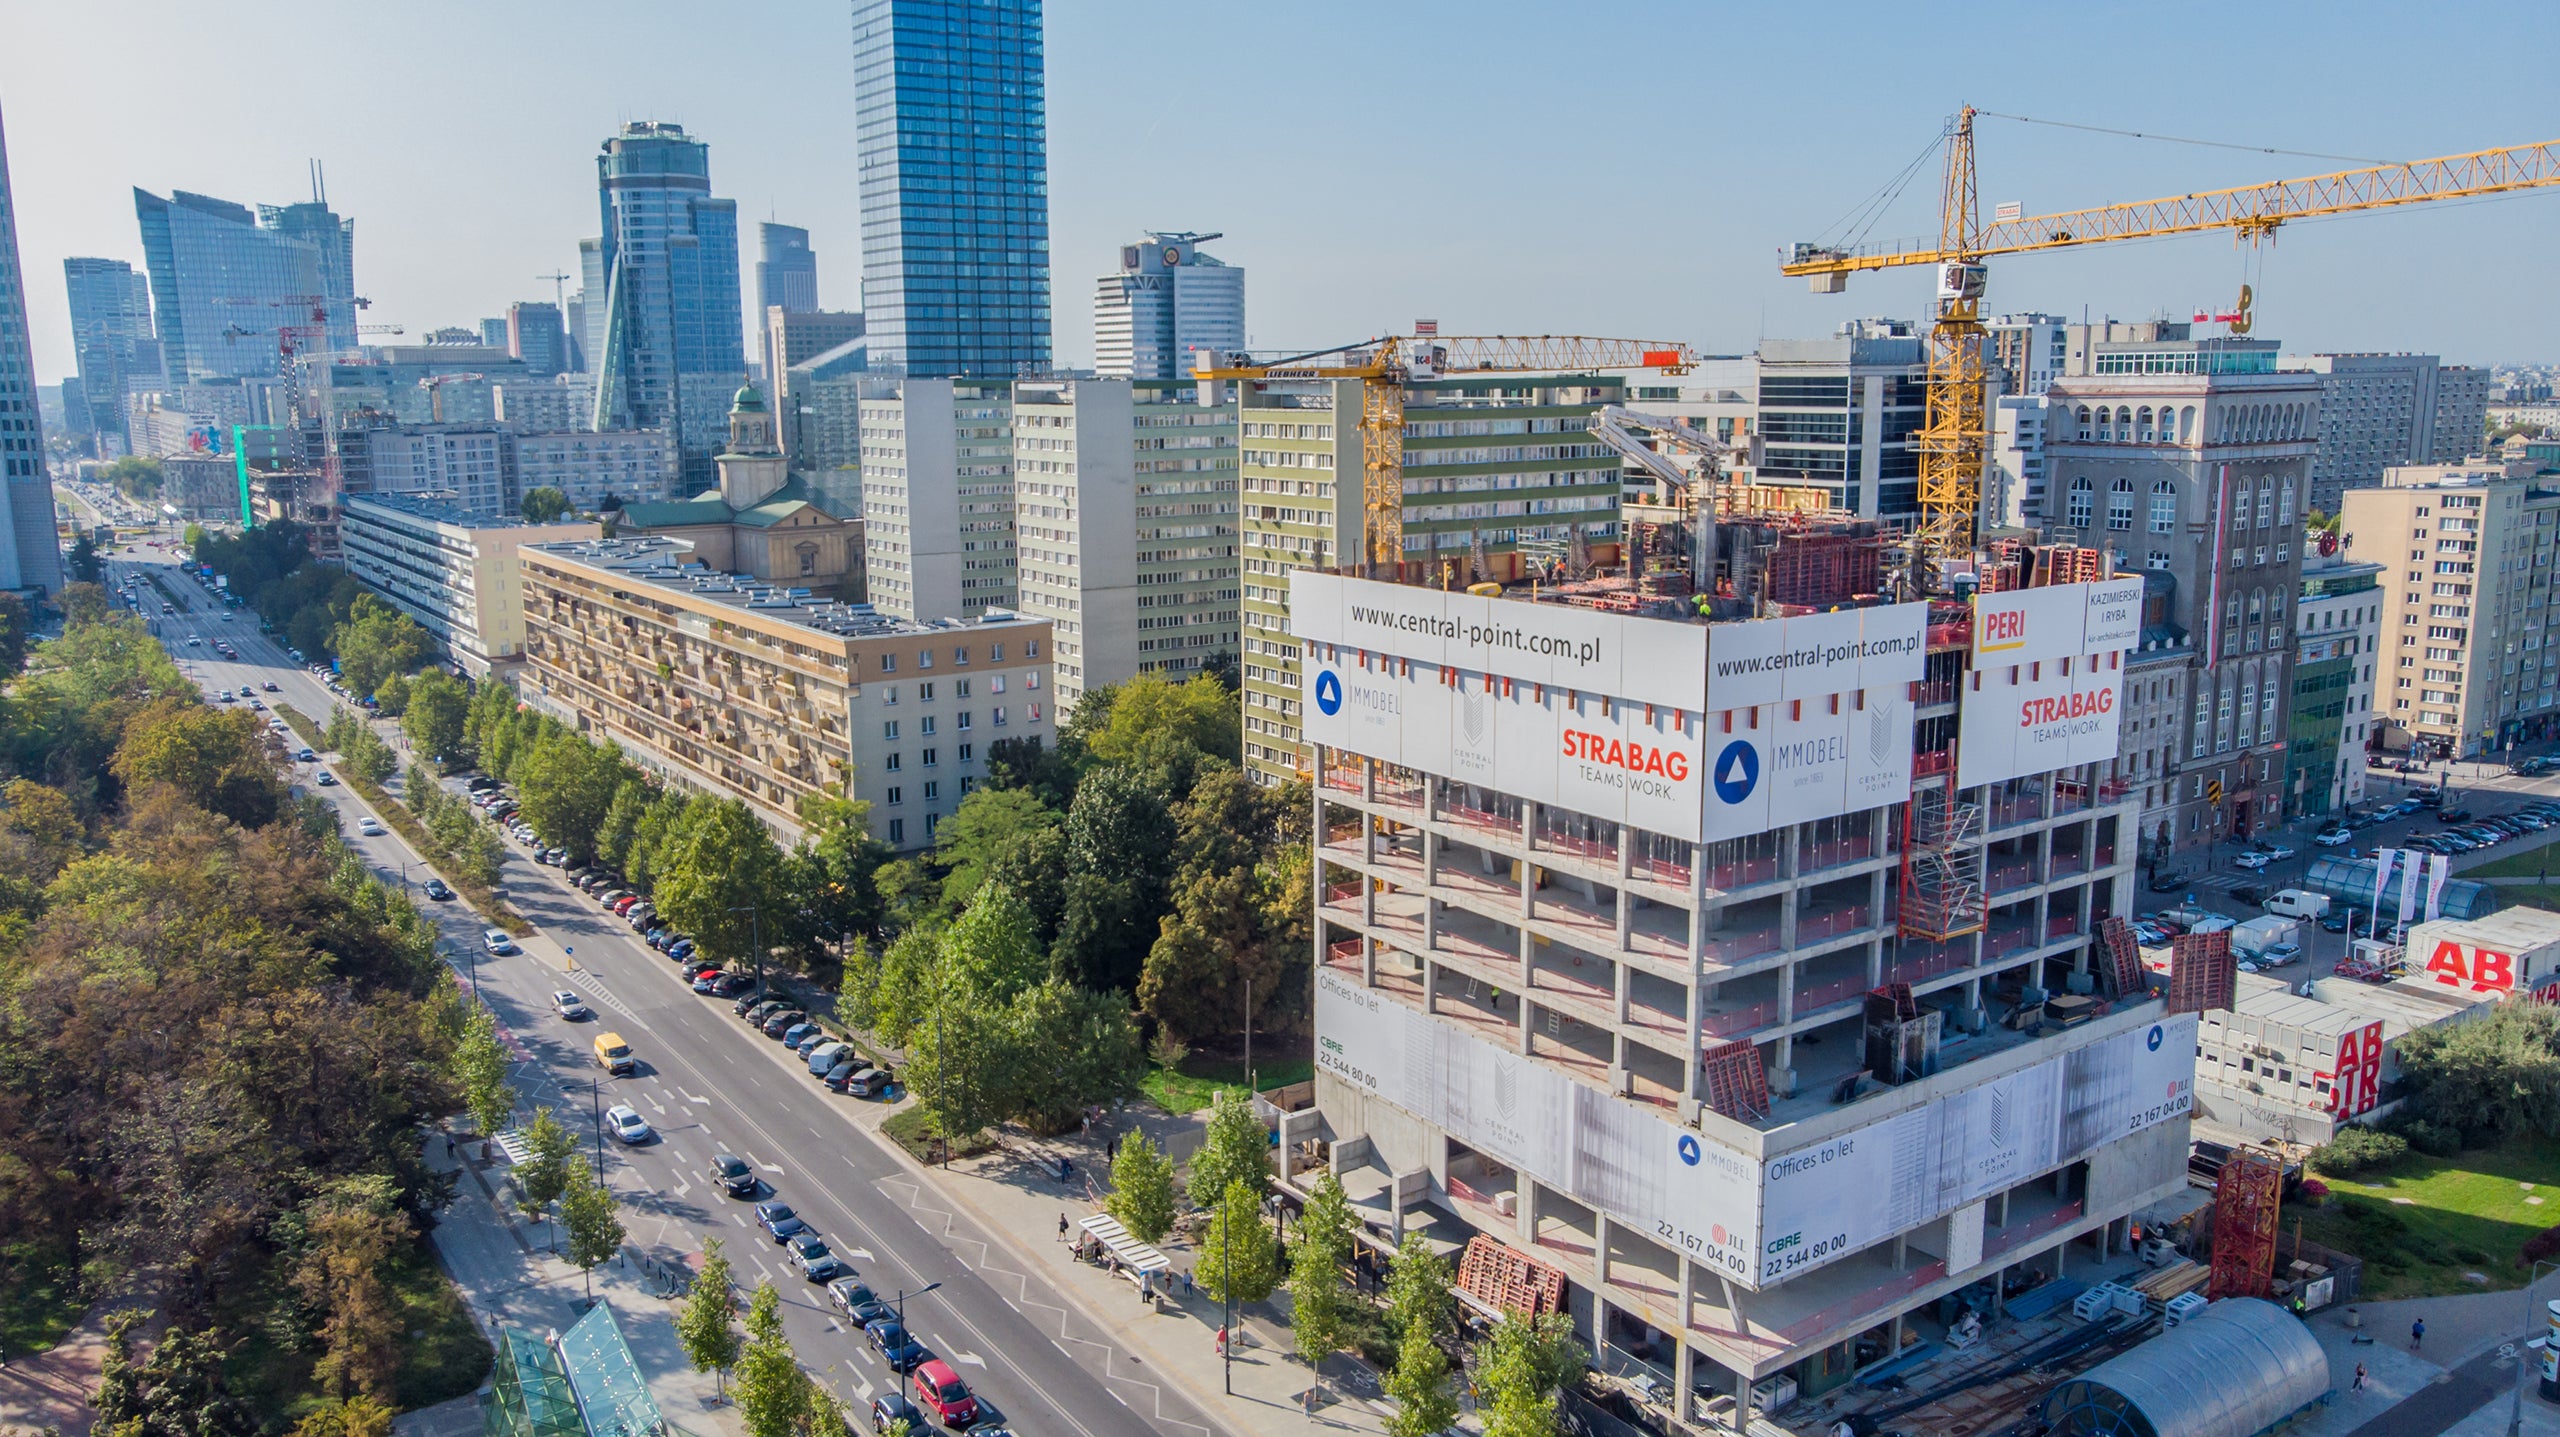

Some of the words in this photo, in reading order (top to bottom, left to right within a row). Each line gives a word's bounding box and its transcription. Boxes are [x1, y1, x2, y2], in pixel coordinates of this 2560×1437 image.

[2090, 588, 2141, 606] KAZIMIERSKI
[1986, 609, 2025, 642] PERI
[2106, 609, 2126, 623] RYBA
[1352, 605, 1601, 666] www.central-point.com.pl
[1717, 630, 1920, 677] www.central-point.com.pl
[1350, 685, 1401, 715] IMMOBEL
[2020, 687, 2113, 728] STRABAG
[2033, 724, 2067, 744] TEAMS
[2071, 718, 2103, 736] WORK.
[1454, 749, 1492, 765] CENTRAL
[1460, 759, 1485, 771] POINT
[1562, 728, 1689, 782] STRABAG
[1772, 736, 1846, 772] IMMOBEL
[1579, 765, 1624, 789] TEAMS
[1629, 776, 1676, 802] WORK.
[1859, 771, 1899, 785] CENTRAL
[1866, 781, 1891, 792] POINT
[1320, 975, 1352, 1001] Offices
[1354, 991, 1364, 1006] to
[1367, 995, 1379, 1013] let
[1320, 1036, 1343, 1055] CBRE
[1320, 1051, 1331, 1066] 22
[1333, 1058, 1349, 1074] 544
[1352, 1067, 1363, 1081] 80
[1365, 1074, 1377, 1089] 00
[2130, 1114, 2141, 1129] 22
[2144, 1106, 2161, 1123] 167
[2163, 1101, 2174, 1115] 04
[2177, 1095, 2188, 1110] 00
[1485, 1118, 1525, 1143] CENTRAL
[1492, 1130, 1517, 1148] POINT
[1707, 1151, 1751, 1181] IMMOBEL
[1771, 1154, 1817, 1180] Offices
[1821, 1149, 1834, 1163] to
[1839, 1139, 1854, 1157] let
[1978, 1149, 2017, 1169] CENTRAL
[1985, 1159, 2010, 1176] POINT
[1657, 1220, 1674, 1239] 22
[1679, 1231, 1703, 1252] 167
[1707, 1244, 1724, 1263] 04
[1728, 1255, 1746, 1274] 00
[1728, 1234, 1747, 1253] JLL
[1766, 1259, 1782, 1277] 22
[1786, 1248, 1809, 1269] 544
[1812, 1241, 1828, 1258] 80
[1831, 1233, 1846, 1251] 00
[1767, 1231, 1802, 1254] CBRE
